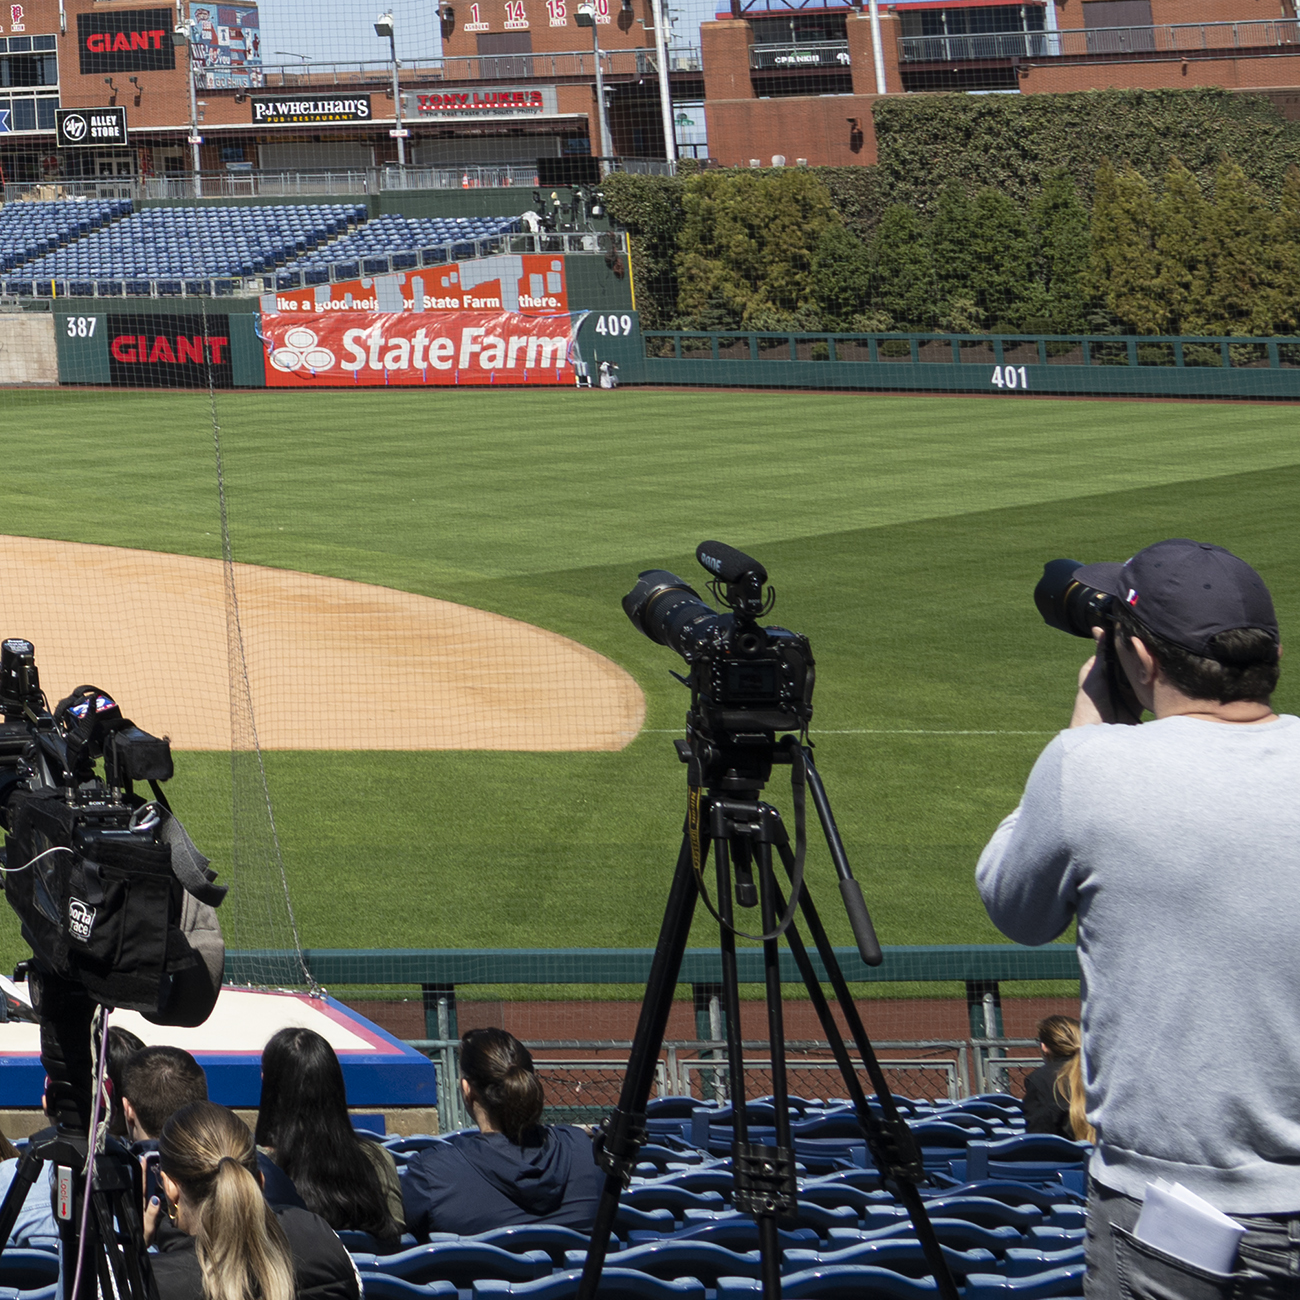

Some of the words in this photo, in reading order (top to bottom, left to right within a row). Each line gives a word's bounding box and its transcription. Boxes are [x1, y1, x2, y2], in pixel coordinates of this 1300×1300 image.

[470, 3, 480, 23] 1
[505, 0, 525, 21] 14
[87, 30, 165, 52] GIANT
[417, 94, 468, 105] TONY
[473, 91, 542, 103] LUKE'S
[90, 115, 117, 126] ALLEY
[516, 108, 538, 116] Philly
[91, 126, 119, 137] STORE
[277, 297, 297, 310] ike
[302, 300, 311, 310] a
[423, 296, 460, 308] State
[463, 296, 499, 308] Farm
[519, 295, 561, 308] there.
[67, 316, 96, 338] 387
[596, 315, 632, 336] 409
[111, 335, 229, 363] GIANT
[992, 366, 1028, 390] 401
